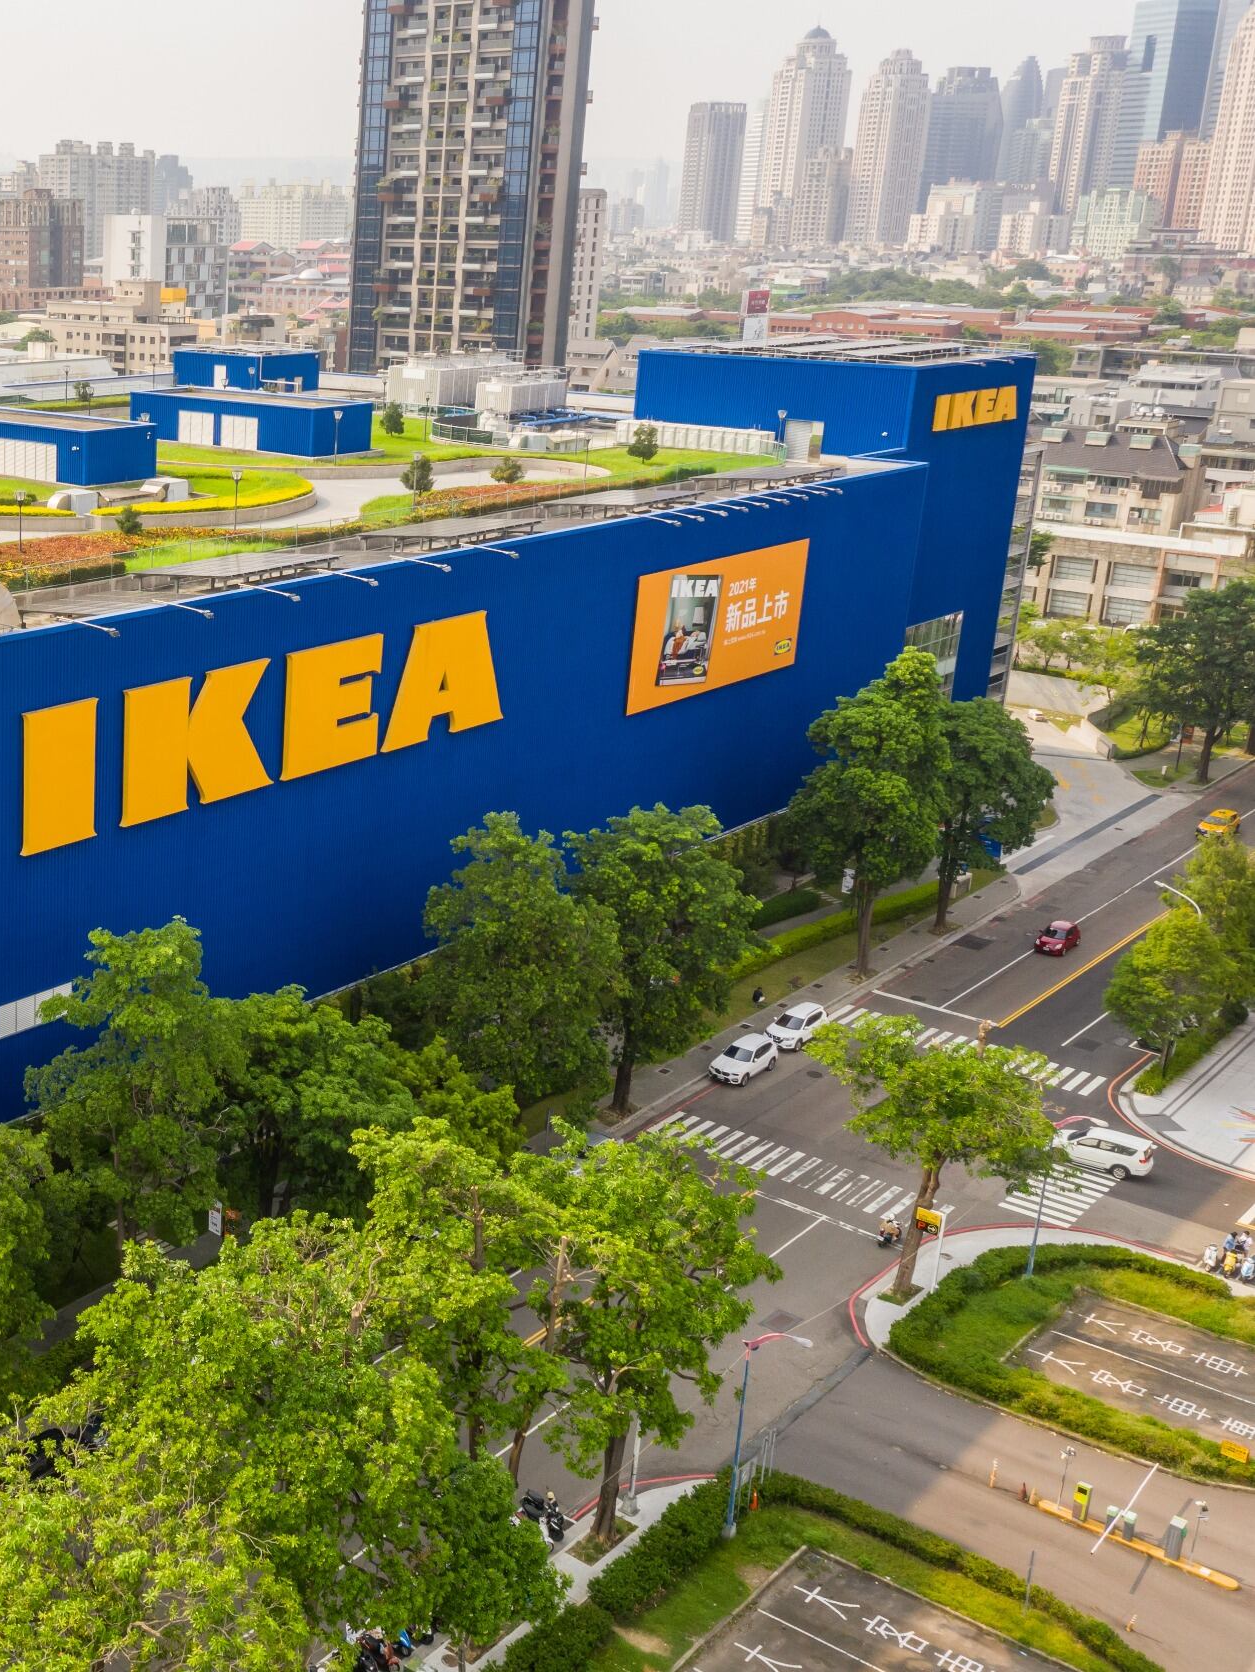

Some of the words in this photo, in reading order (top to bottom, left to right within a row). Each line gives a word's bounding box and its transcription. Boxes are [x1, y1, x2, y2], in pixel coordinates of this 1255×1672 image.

[932, 385, 1017, 432] IKEA
[671, 579, 719, 598] IKEA
[729, 577, 758, 597] 2021年
[725, 590, 790, 633] 新品上市
[20, 610, 503, 857] IKEA
[1066, 1310, 1248, 1378] 大客車
